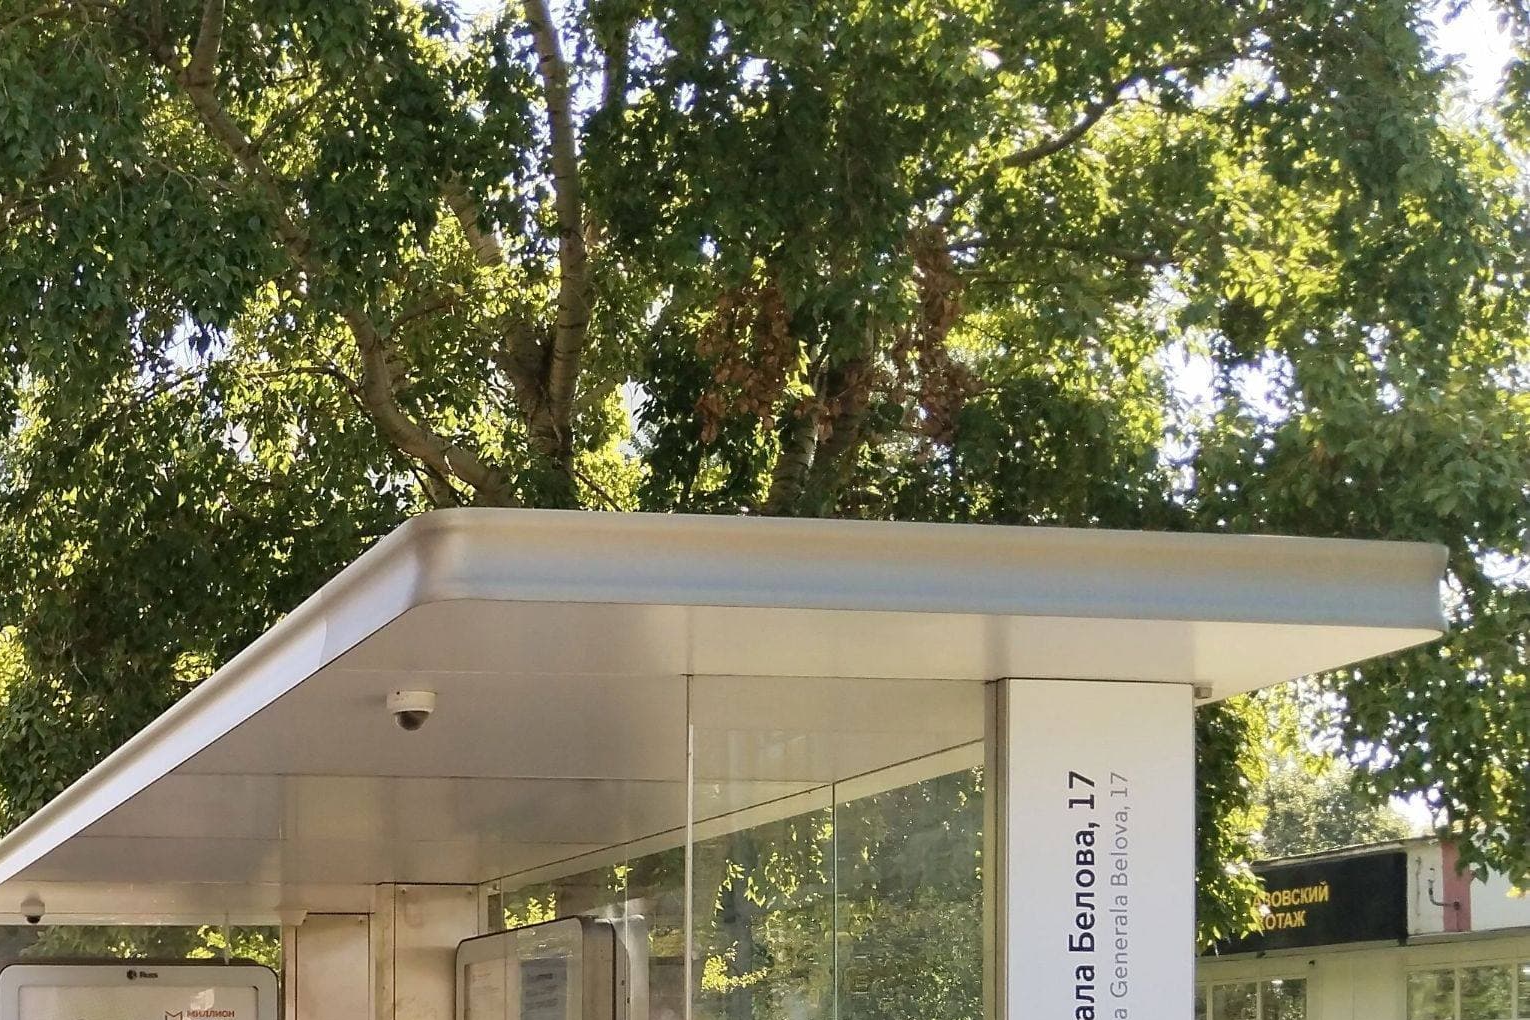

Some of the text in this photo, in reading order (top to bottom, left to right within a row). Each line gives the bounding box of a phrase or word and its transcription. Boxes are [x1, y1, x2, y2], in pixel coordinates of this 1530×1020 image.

[1068, 770, 1095, 809] 17
[1109, 771, 1129, 798] 17
[1068, 822, 1101, 952] Белова,
[1109, 806, 1131, 887] Belova,
[1109, 894, 1130, 998] Generala
